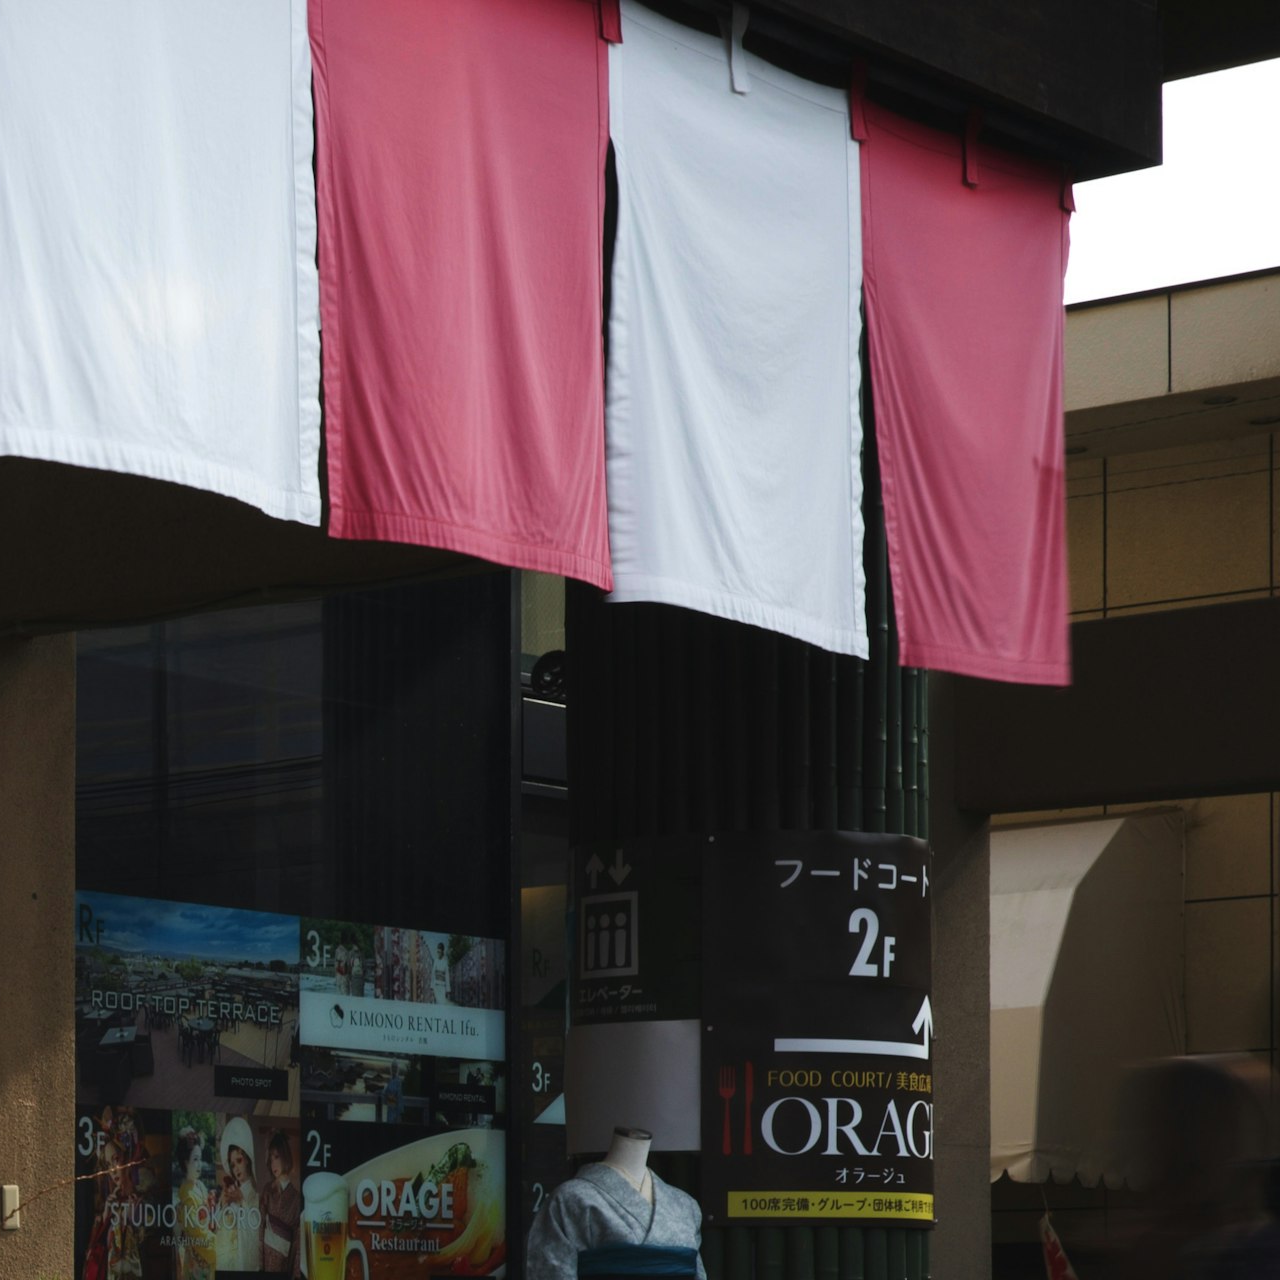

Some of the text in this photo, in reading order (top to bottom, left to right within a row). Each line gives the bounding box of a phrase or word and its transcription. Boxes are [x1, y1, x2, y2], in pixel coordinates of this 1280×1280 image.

[79, 903, 105, 945] RF
[305, 929, 332, 969] 3F
[848, 907, 896, 978] 2F
[91, 989, 280, 1024] ROOF TOP TERRACE
[578, 985, 643, 1004] エレベーター
[349, 1010, 403, 1030] KIMONO
[408, 1015, 457, 1036] RENTAL
[231, 1076, 272, 1088] PHOTO SPOT
[531, 1061, 551, 1092] 3F
[767, 1070, 822, 1088] FOOD
[438, 1091, 488, 1104] KIMONO RENTAL
[78, 1116, 105, 1158] 3F
[306, 1129, 332, 1168] 2F
[835, 1167, 906, 1184] オラージュ
[355, 1178, 455, 1219] ORAGE
[532, 1182, 549, 1213] 2
[110, 1202, 262, 1231] STUDIO KOKORO
[369, 1231, 441, 1253] Restaurant
